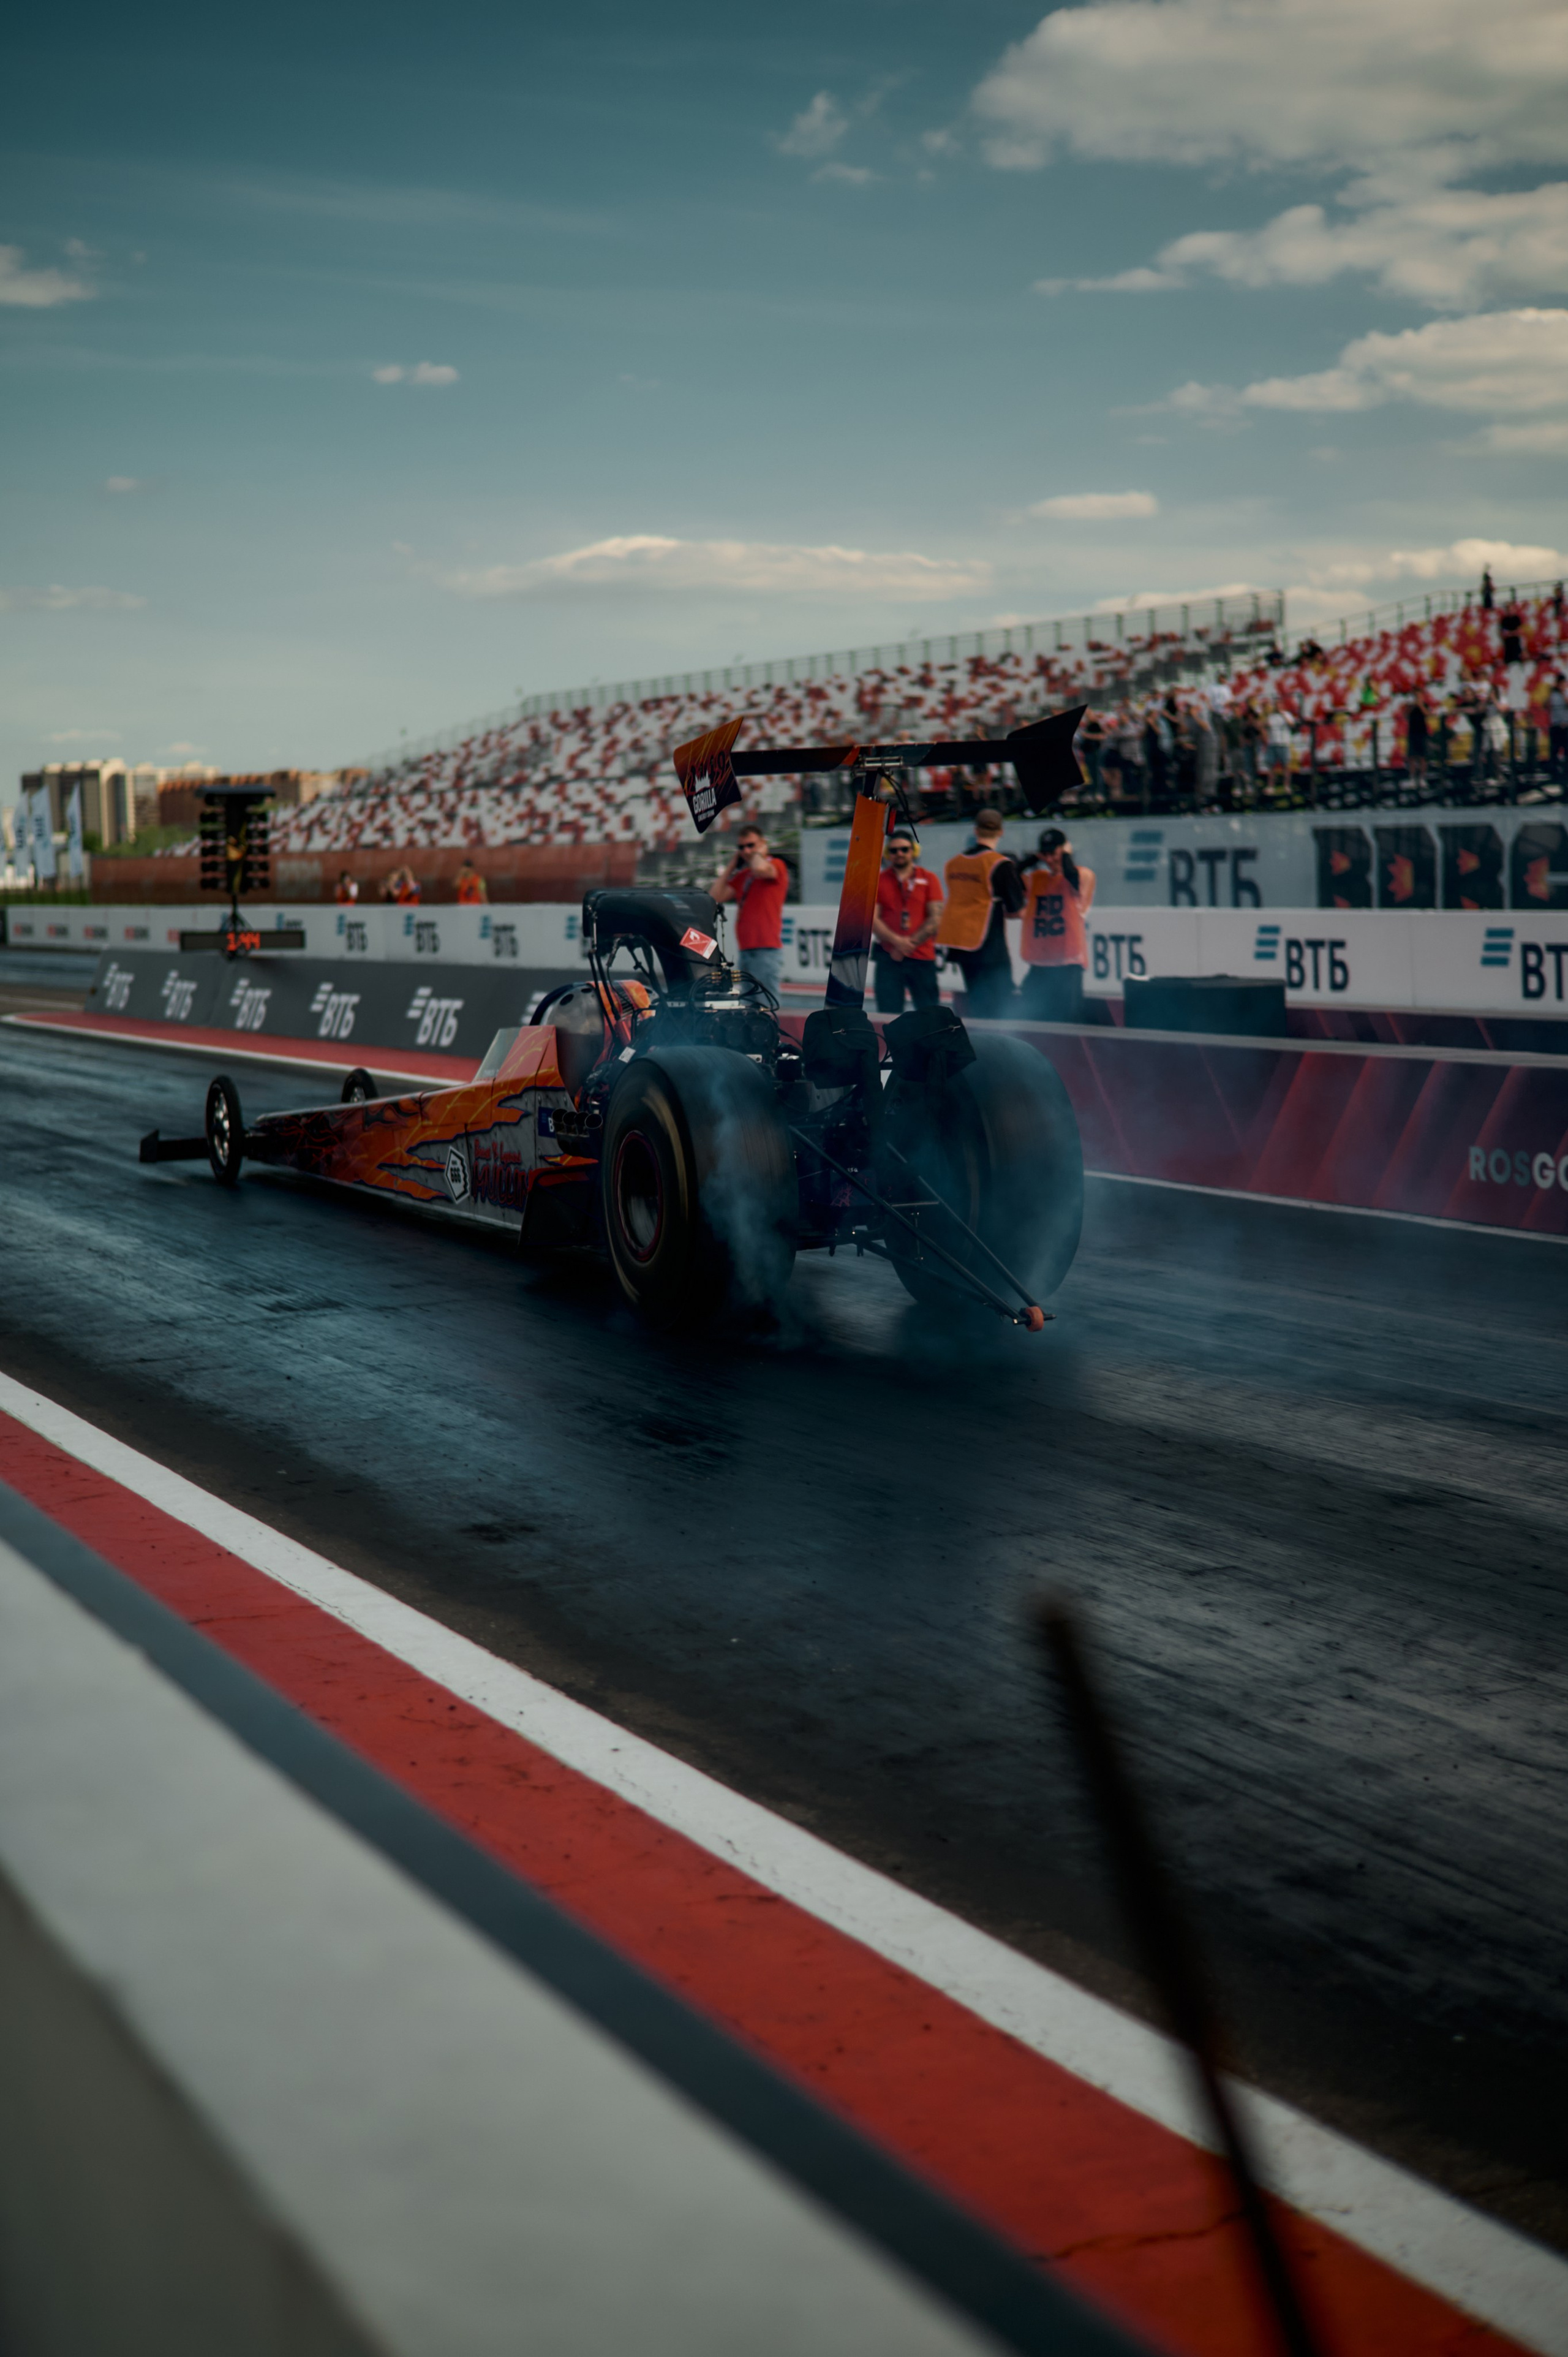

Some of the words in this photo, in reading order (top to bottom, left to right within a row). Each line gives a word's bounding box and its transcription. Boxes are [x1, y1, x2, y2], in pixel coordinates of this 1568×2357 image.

[692, 787, 717, 815] GORILLA
[1170, 848, 1262, 907] ВТБ
[1093, 935, 1145, 980] ВТБ
[1286, 939, 1348, 991] ВТБ
[235, 987, 272, 1031] ВТБ
[318, 992, 361, 1040] ВТБ
[416, 997, 465, 1047] ВТБ
